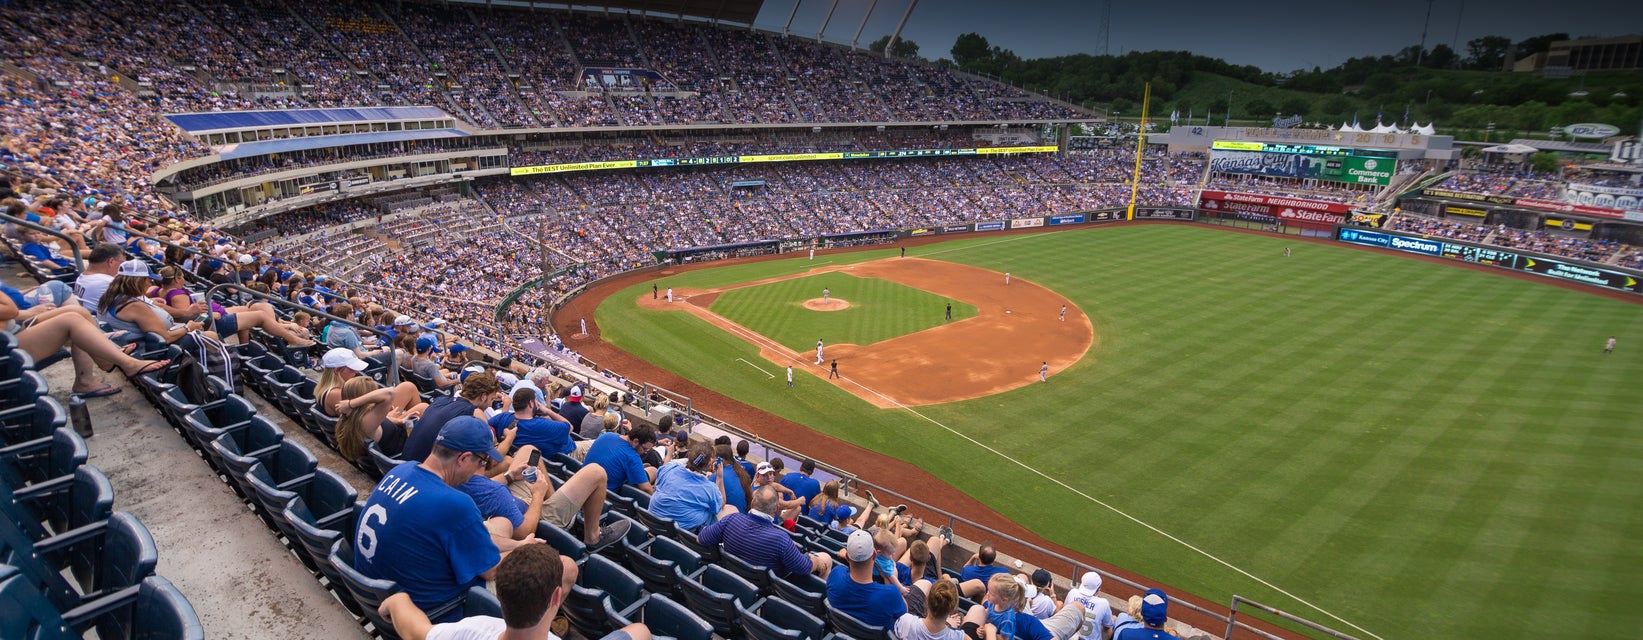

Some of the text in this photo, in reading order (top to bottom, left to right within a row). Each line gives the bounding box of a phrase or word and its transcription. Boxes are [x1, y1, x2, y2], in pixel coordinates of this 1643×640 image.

[1356, 134, 1370, 143] 20
[1383, 135, 1395, 144] 10
[1411, 136, 1418, 144] 5
[1211, 153, 1289, 171] Kansas City
[1349, 168, 1389, 177] Commerce
[1268, 198, 1328, 210] NEIGHBORHOOD
[1392, 238, 1437, 251] Spectrum
[1571, 267, 1600, 276] Network
[1575, 273, 1608, 285] Unlimited
[378, 474, 418, 504] CAIN
[358, 503, 387, 559] 6
